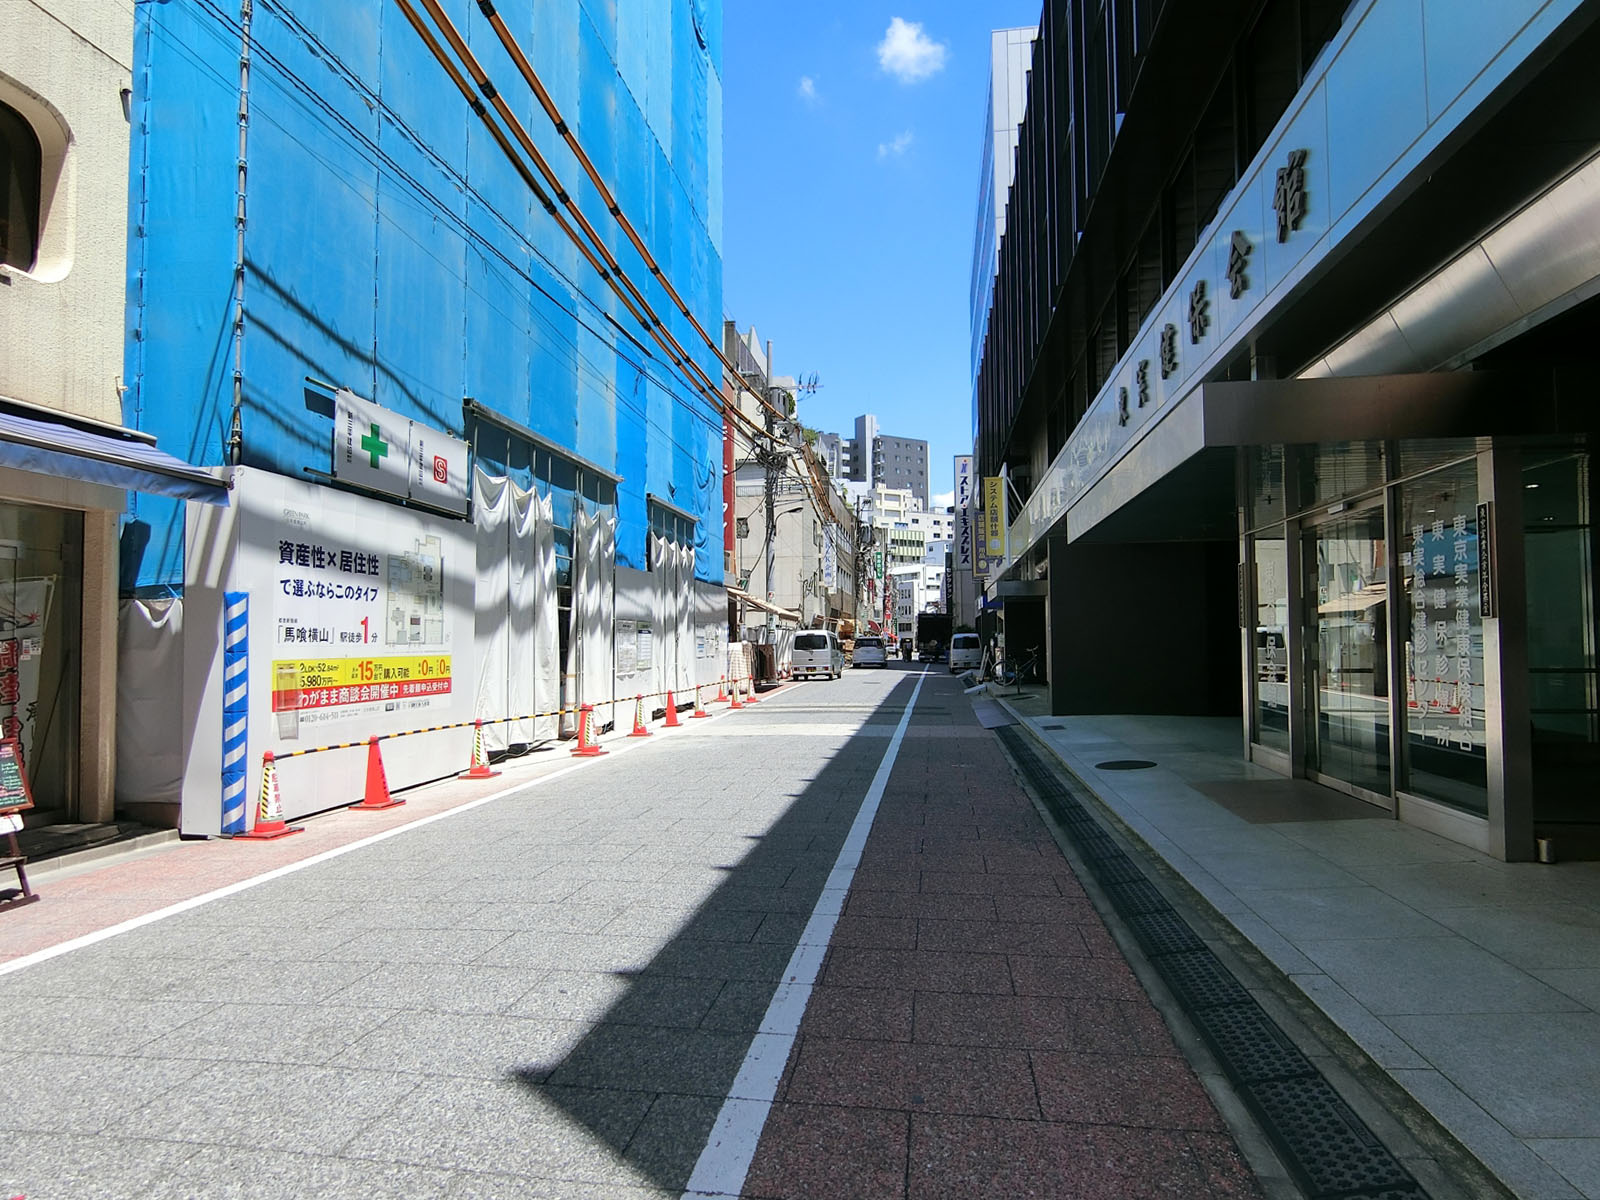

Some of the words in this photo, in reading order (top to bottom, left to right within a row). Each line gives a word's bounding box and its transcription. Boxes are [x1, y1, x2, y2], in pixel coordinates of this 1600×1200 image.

[279, 540, 379, 576] 資産性×居住性
[280, 579, 379, 602] で選ぶならこのタイプ
[299, 683, 400, 706] わがまま商談会開催中
[1412, 524, 1429, 741] 東実総合健診センター
[1431, 519, 1450, 748] 東実健保診療所
[1452, 514, 1473, 752] 東京実業健康保険組合
